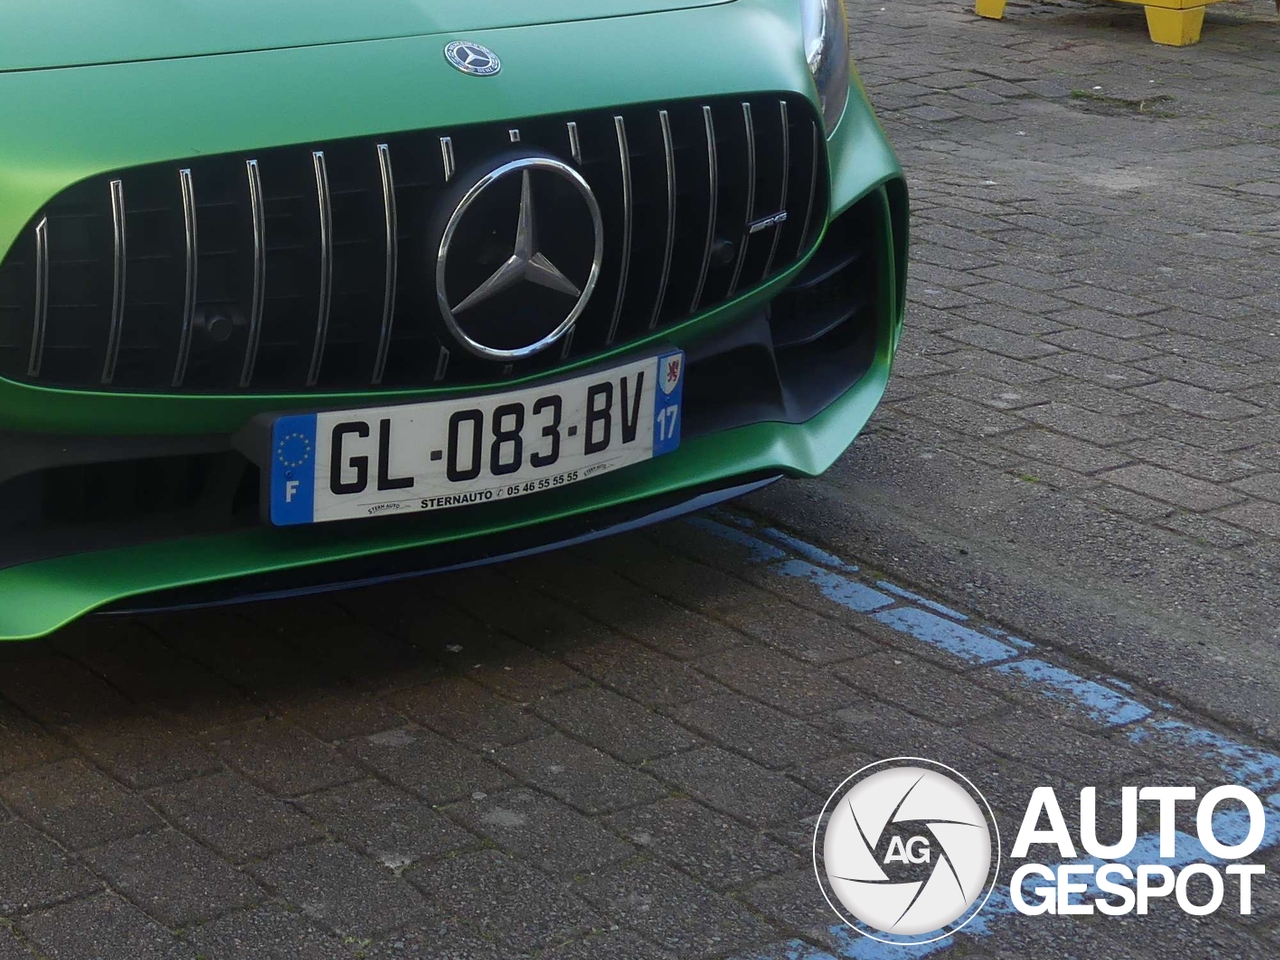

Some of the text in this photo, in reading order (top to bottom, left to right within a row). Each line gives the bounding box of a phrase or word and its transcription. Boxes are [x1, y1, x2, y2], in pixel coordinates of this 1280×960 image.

[329, 371, 645, 495] GL-083-BV
[656, 405, 678, 440] 17
[285, 480, 299, 502] F
[420, 471, 578, 509] STERNAUTO 05 46 55 55 55
